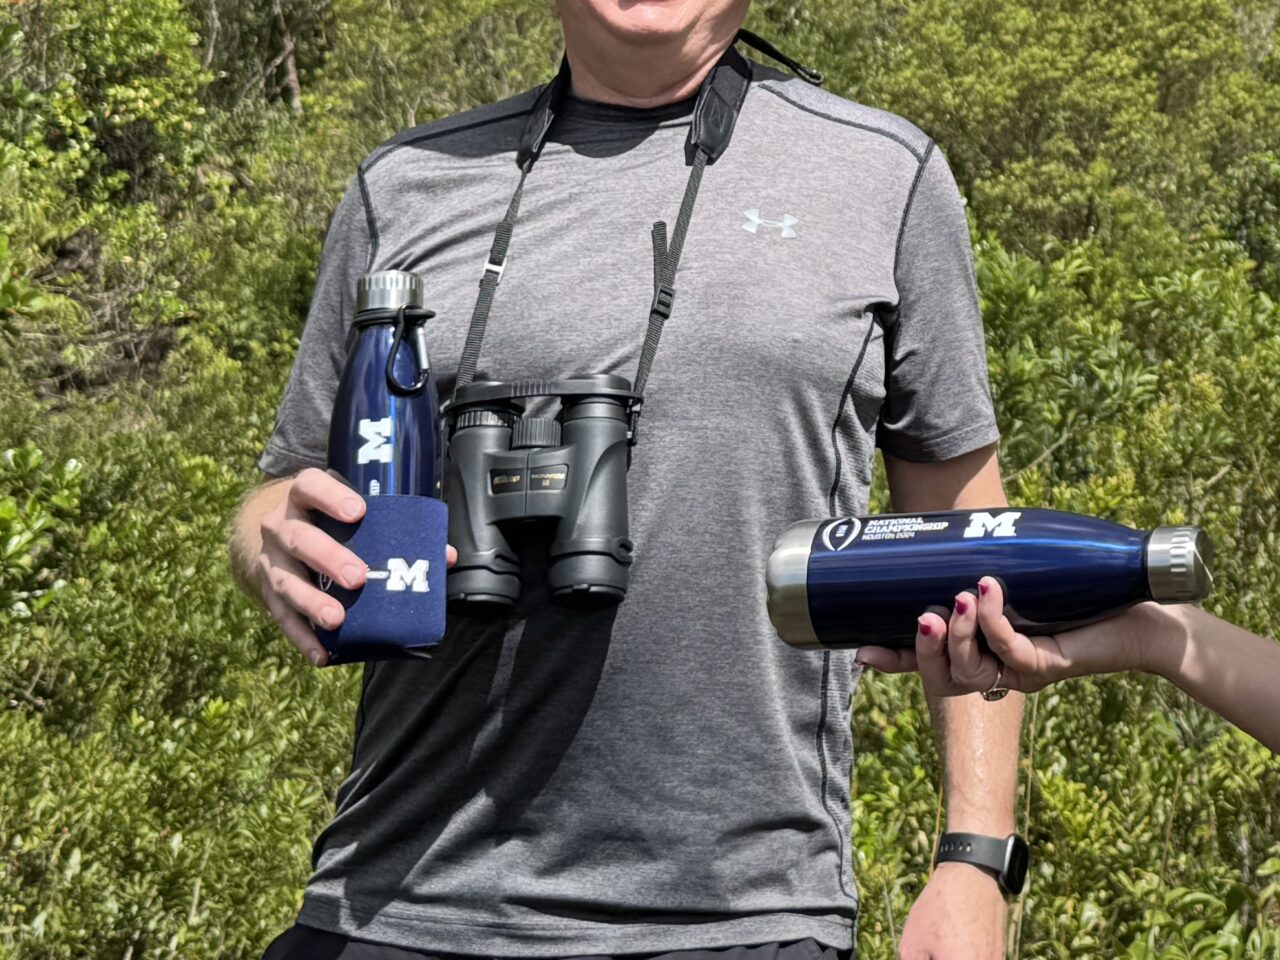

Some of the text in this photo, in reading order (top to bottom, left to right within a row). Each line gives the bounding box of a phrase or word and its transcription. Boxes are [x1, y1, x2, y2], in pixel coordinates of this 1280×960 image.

[357, 416, 393, 464] M
[863, 522, 949, 534] CHAMPIONSHIP
[867, 517, 924, 526] NATIONAL
[963, 511, 1022, 538] M
[386, 558, 430, 592] M
